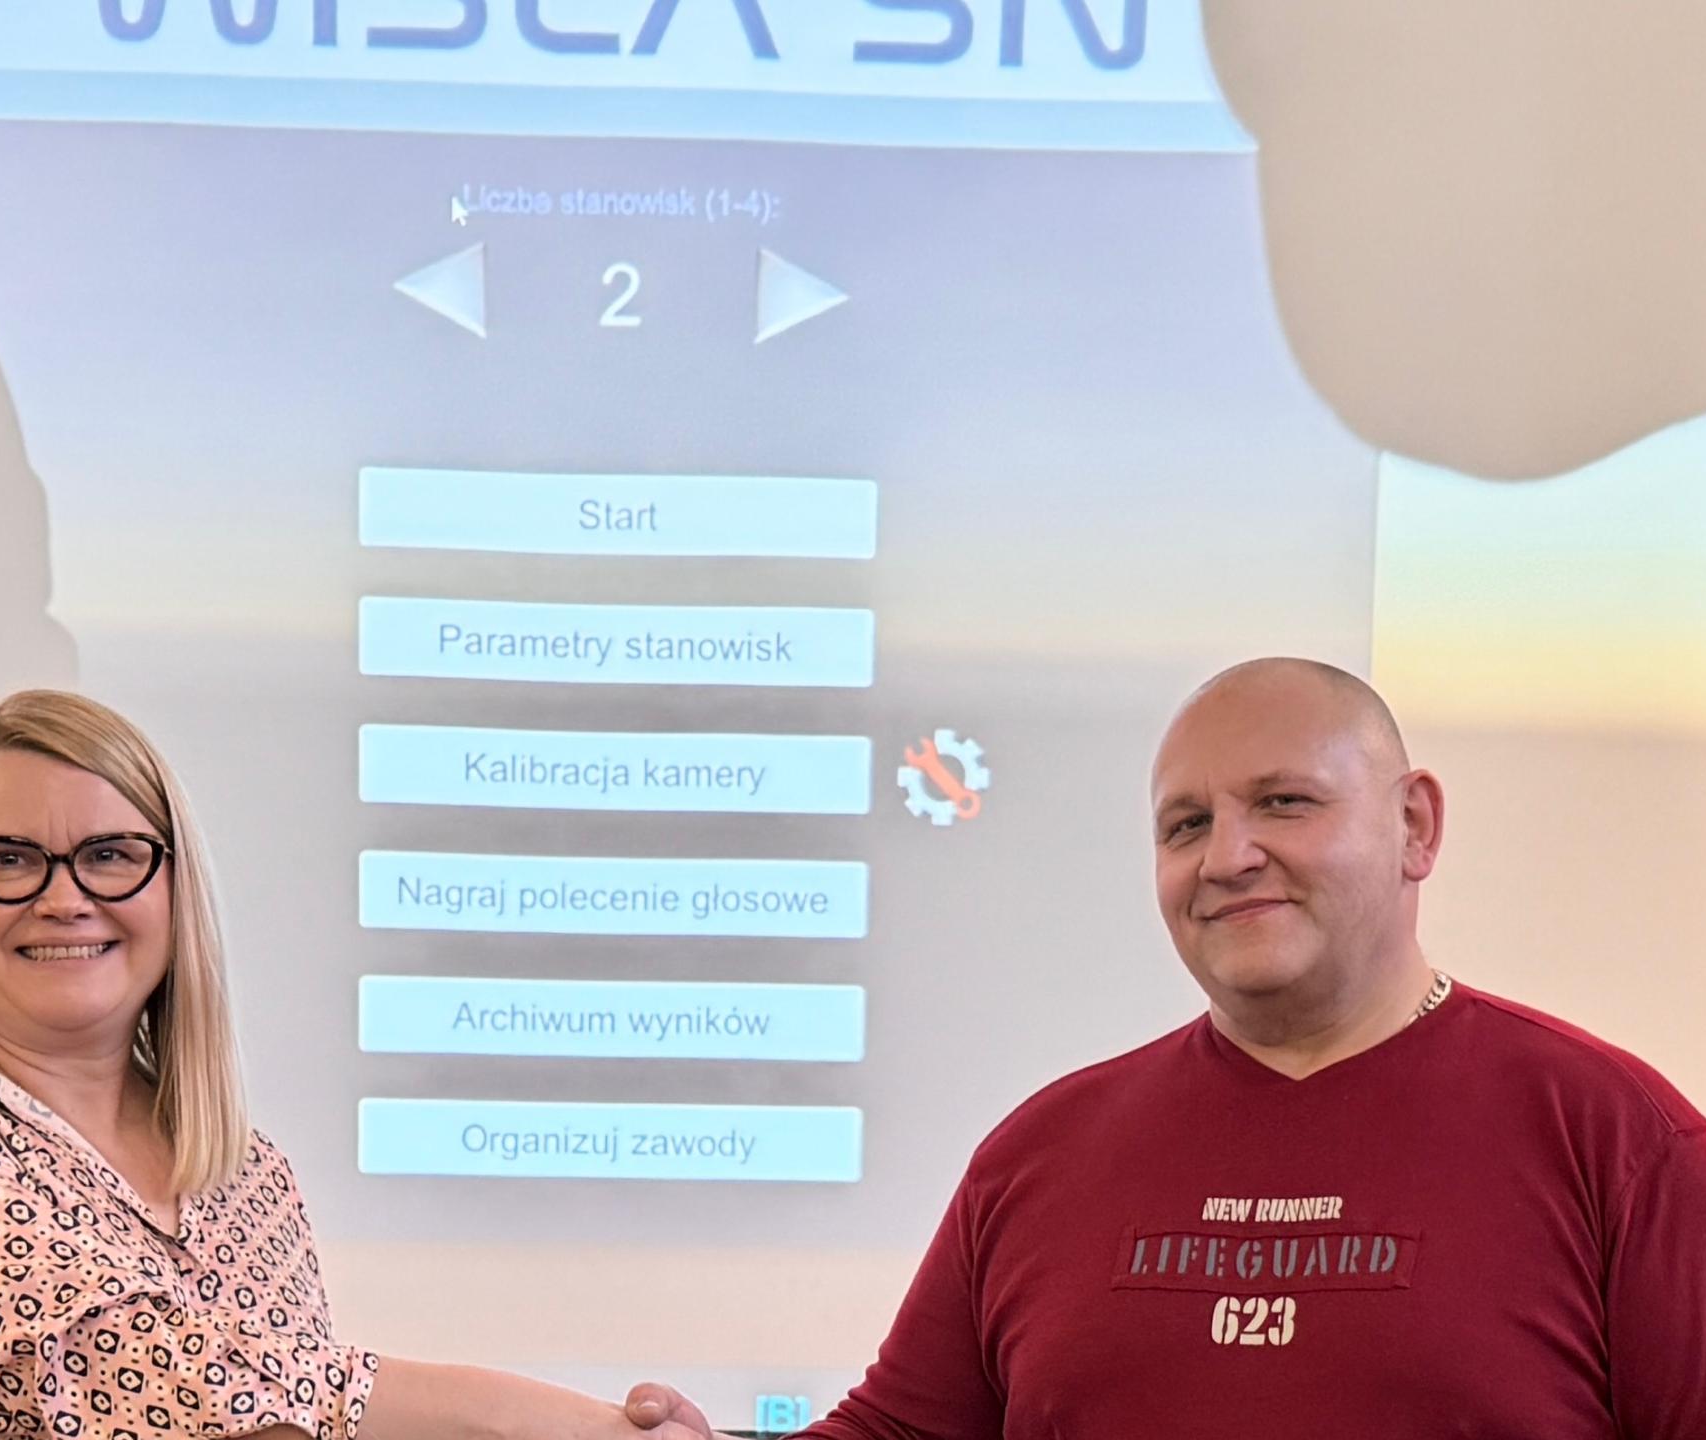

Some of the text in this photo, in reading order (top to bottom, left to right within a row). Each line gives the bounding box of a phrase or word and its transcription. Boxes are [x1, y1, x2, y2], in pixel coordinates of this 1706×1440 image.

[560, 185, 695, 217] stanowisk
[704, 188, 781, 226] (1-4):
[599, 262, 642, 326] 2
[579, 499, 657, 531] Start
[439, 624, 793, 667] Parametry stanowisk
[463, 753, 766, 796] Kalibracja kamery
[397, 876, 830, 919] Nagraj polecenie głosowe
[452, 1001, 771, 1042] Archiwum wyników
[461, 1125, 757, 1164] Organizuj zawody
[1202, 1196, 1343, 1222] NEW RUNNER
[1130, 1235, 1397, 1279] LIFEGUARD
[1211, 1296, 1296, 1346] 623
